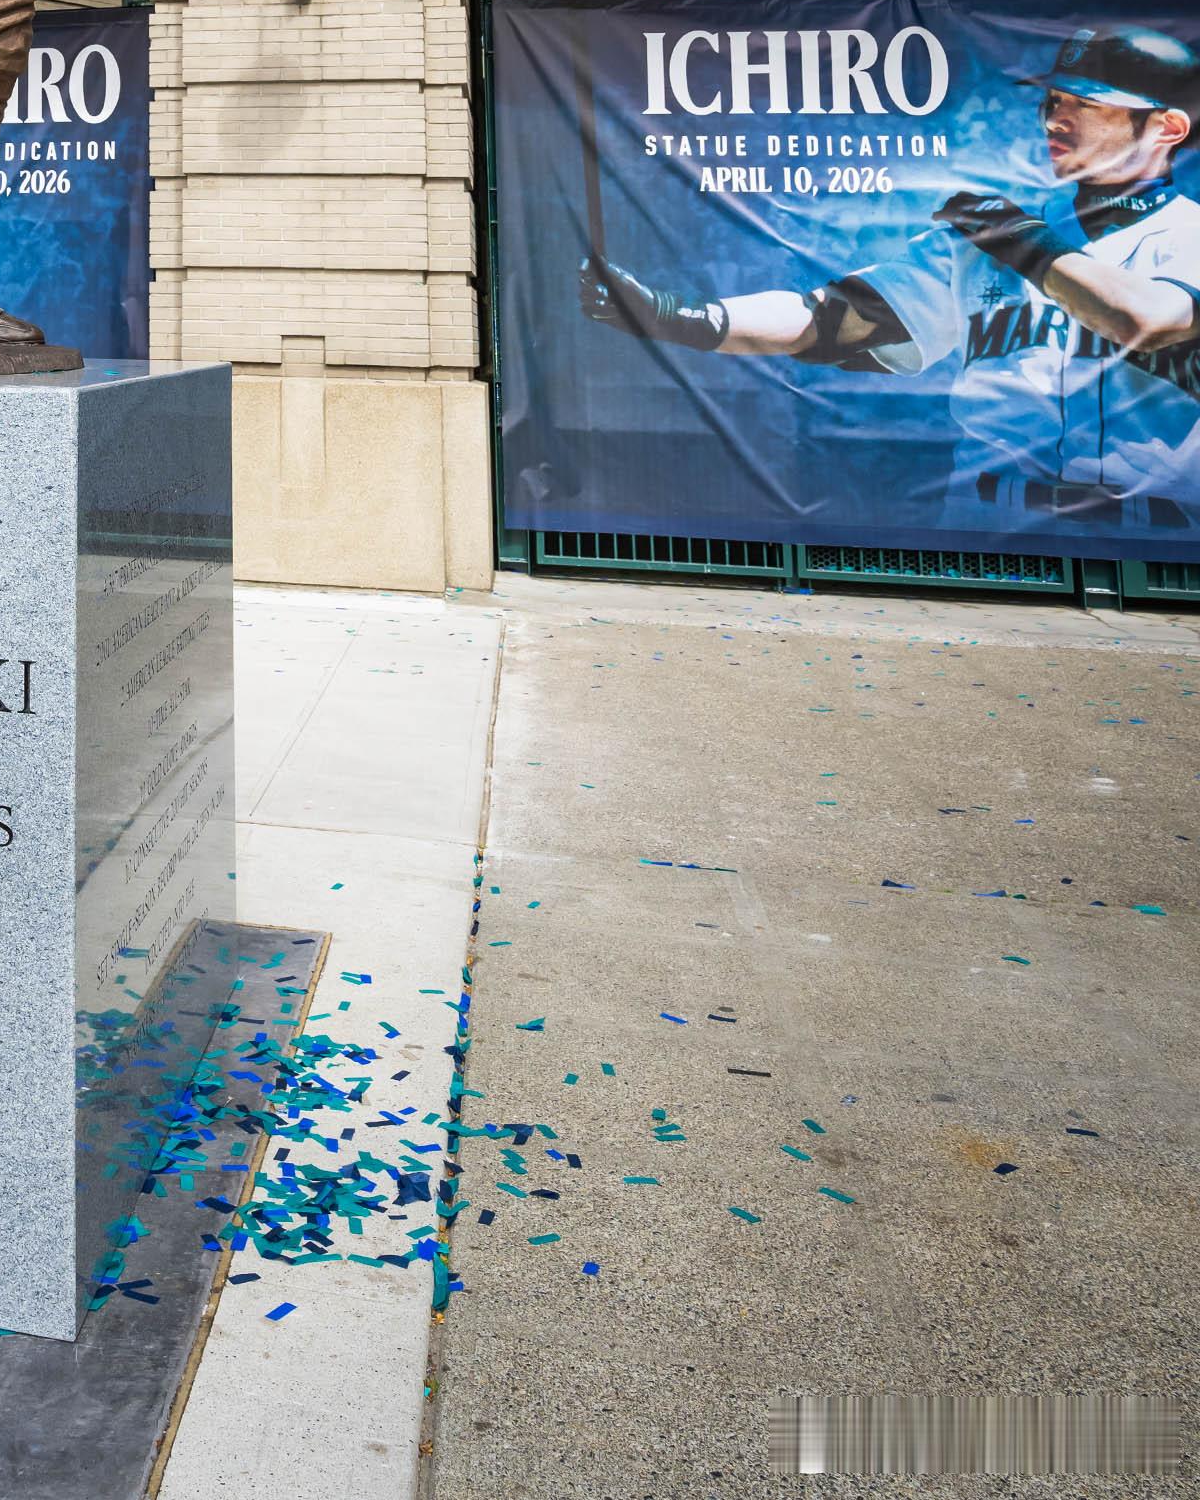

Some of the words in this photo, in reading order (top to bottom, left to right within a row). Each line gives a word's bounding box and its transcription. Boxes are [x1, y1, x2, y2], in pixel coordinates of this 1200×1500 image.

[642, 26, 949, 116] ICHIRO
[645, 135, 749, 157] STATUE
[768, 135, 948, 157] DEDICATION
[19, 169, 71, 194] 2026
[699, 167, 773, 193] APRIL
[783, 167, 818, 197] 10,
[827, 167, 893, 194] 2026
